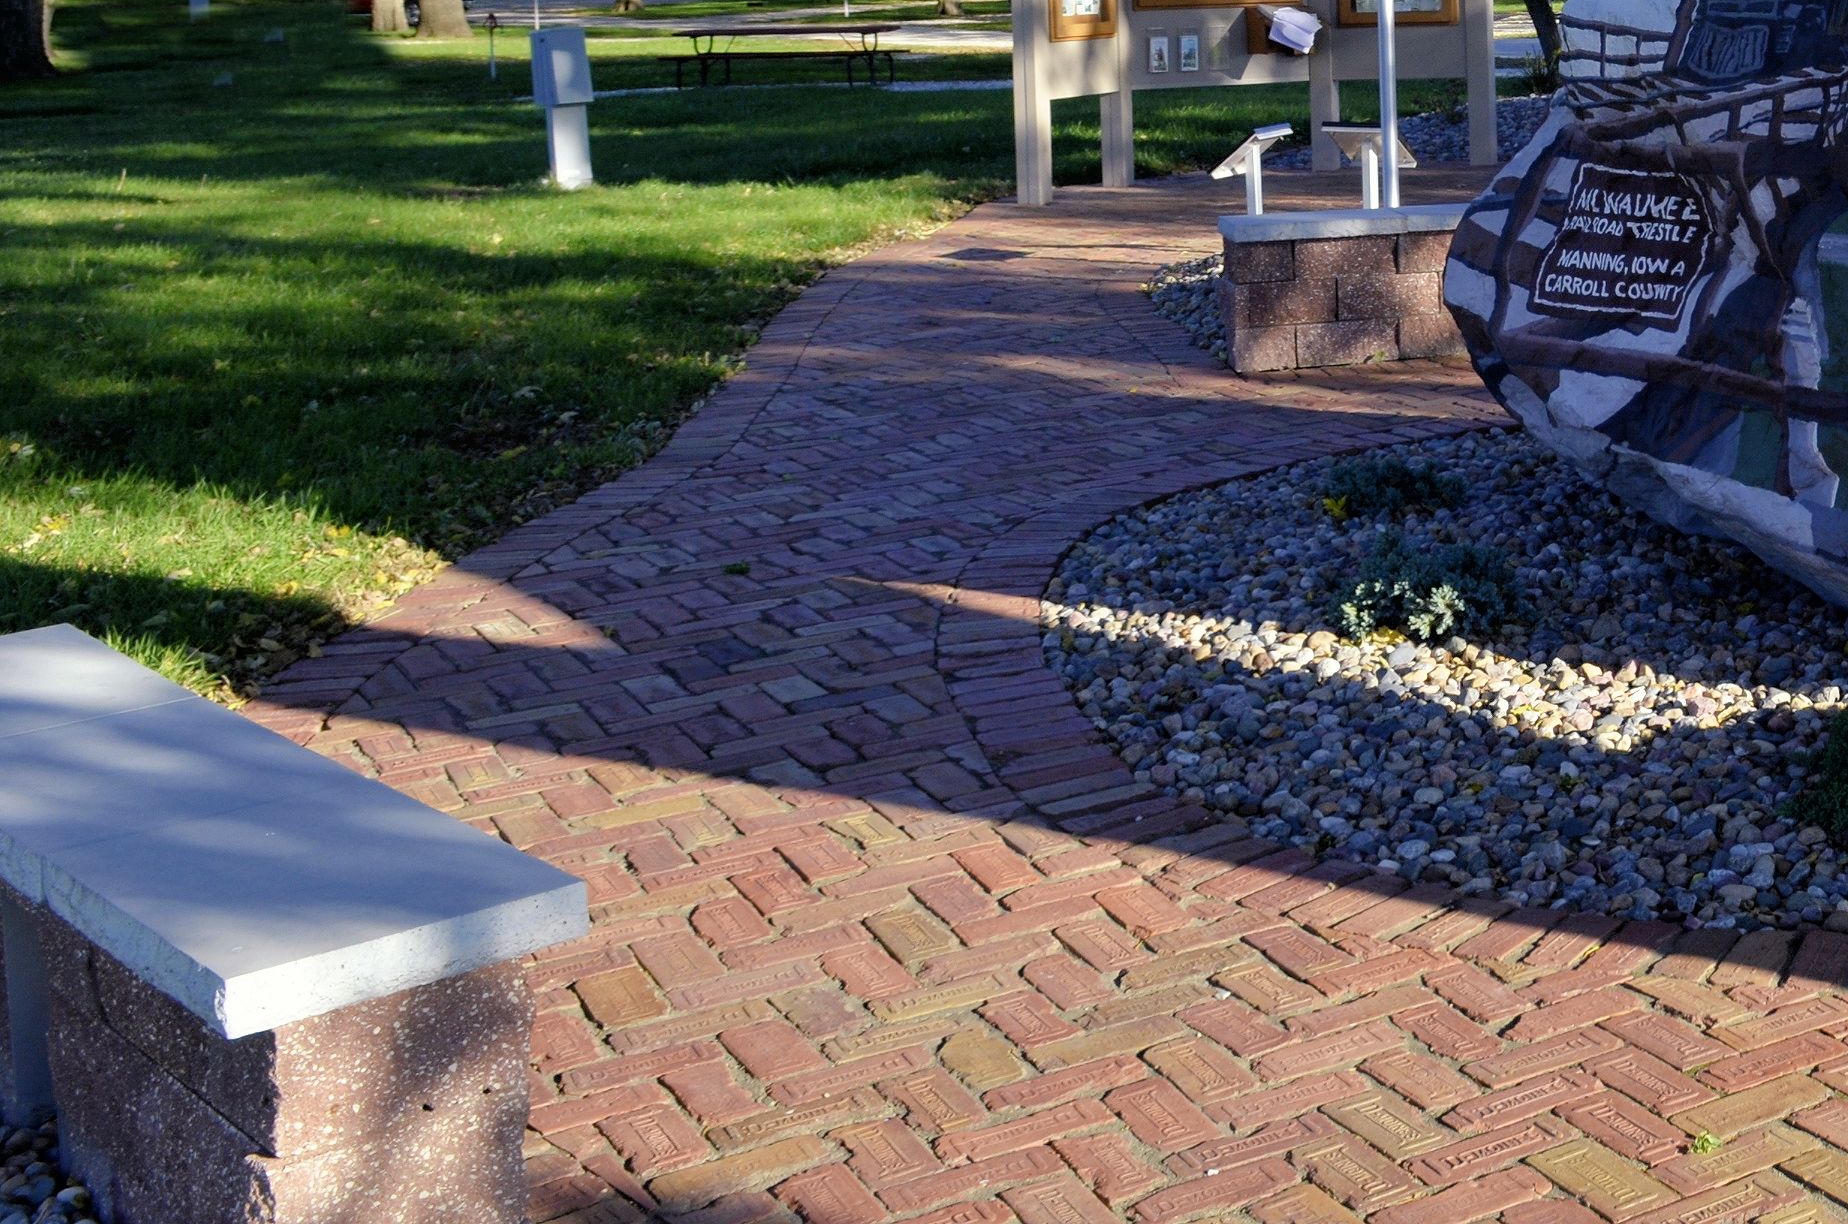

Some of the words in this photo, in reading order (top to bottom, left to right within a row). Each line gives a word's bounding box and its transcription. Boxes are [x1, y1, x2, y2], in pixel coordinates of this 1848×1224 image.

[1626, 221, 1697, 243] TRESTLE
[1557, 248, 1629, 275] MANNING,
[1631, 256, 1685, 276] IOWA
[1545, 273, 1609, 297] CARROLL
[1614, 281, 1684, 302] COUNTY
